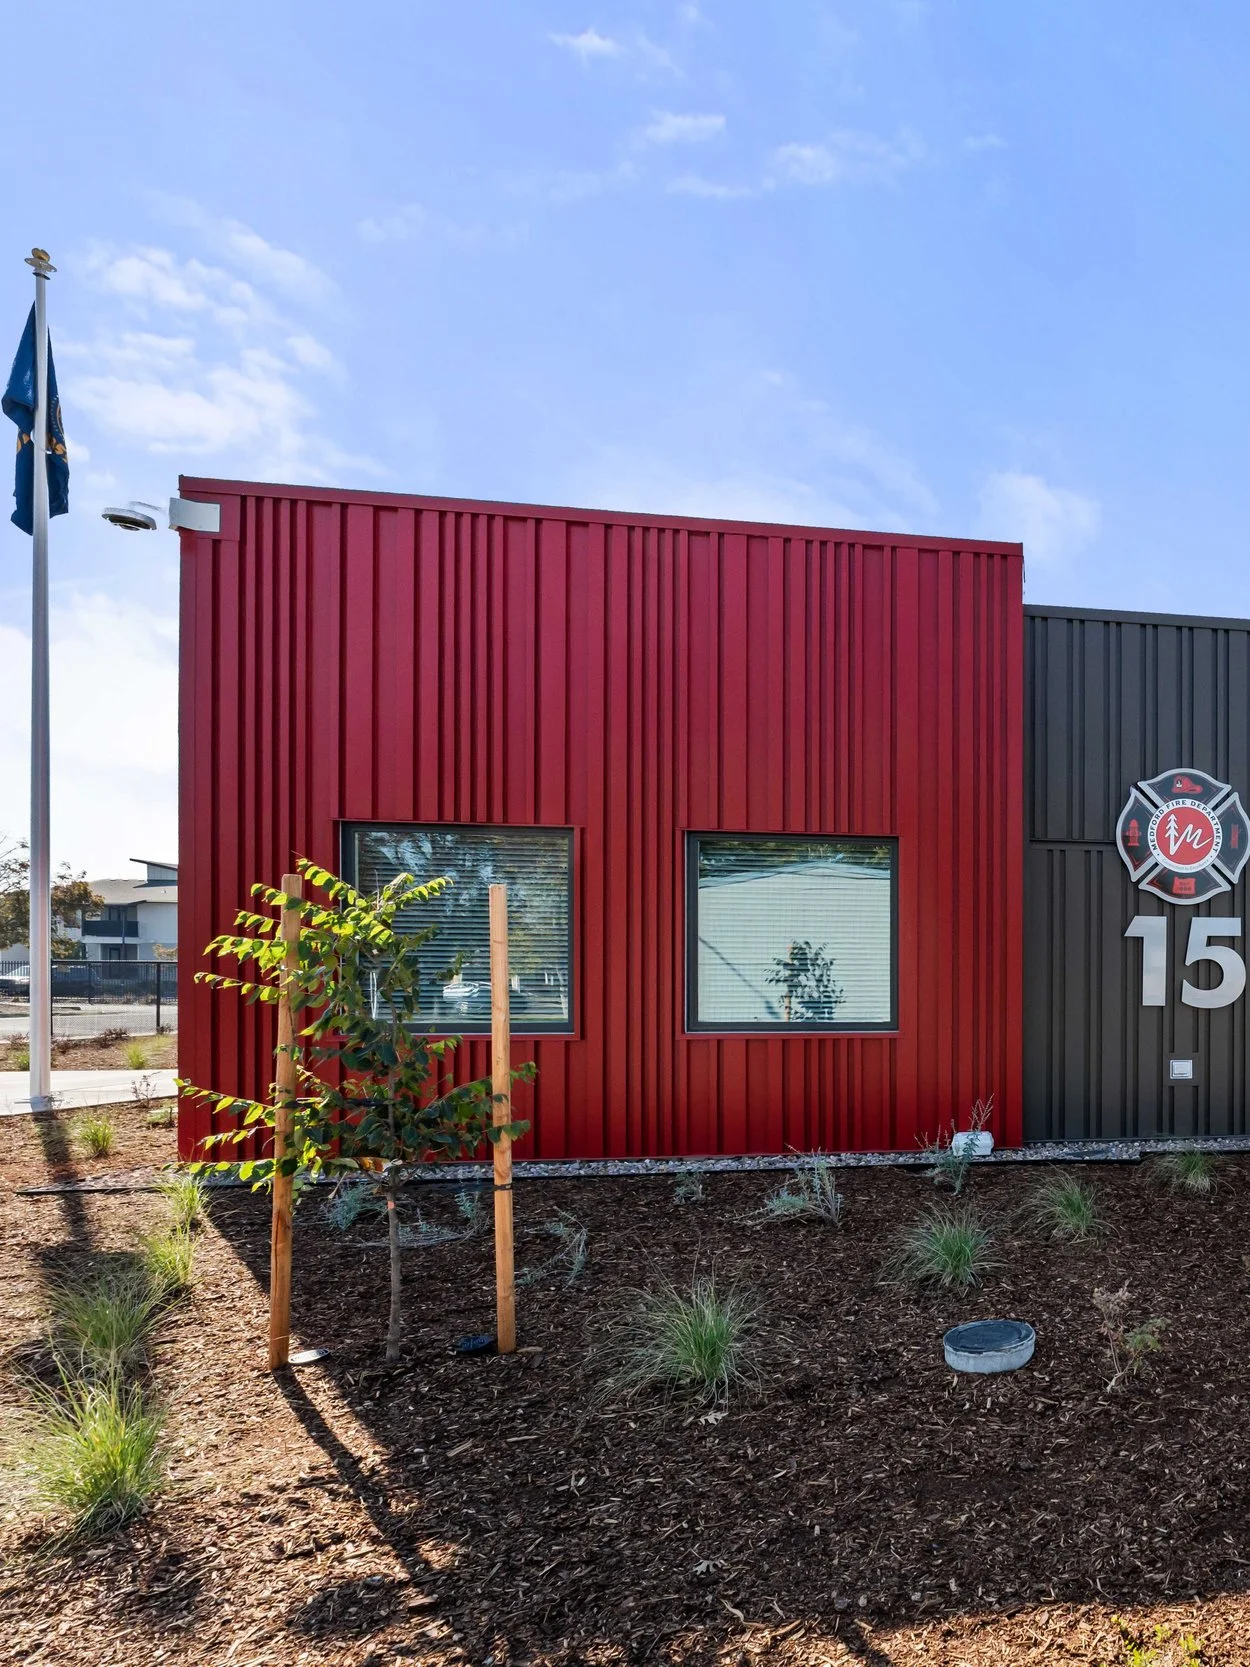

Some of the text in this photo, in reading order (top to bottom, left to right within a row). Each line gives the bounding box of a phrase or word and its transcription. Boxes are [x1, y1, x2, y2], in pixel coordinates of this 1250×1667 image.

[1149, 799, 1221, 853] MEDFORD FIRE DEPARTMENT
[1124, 915, 1247, 1009] 15
